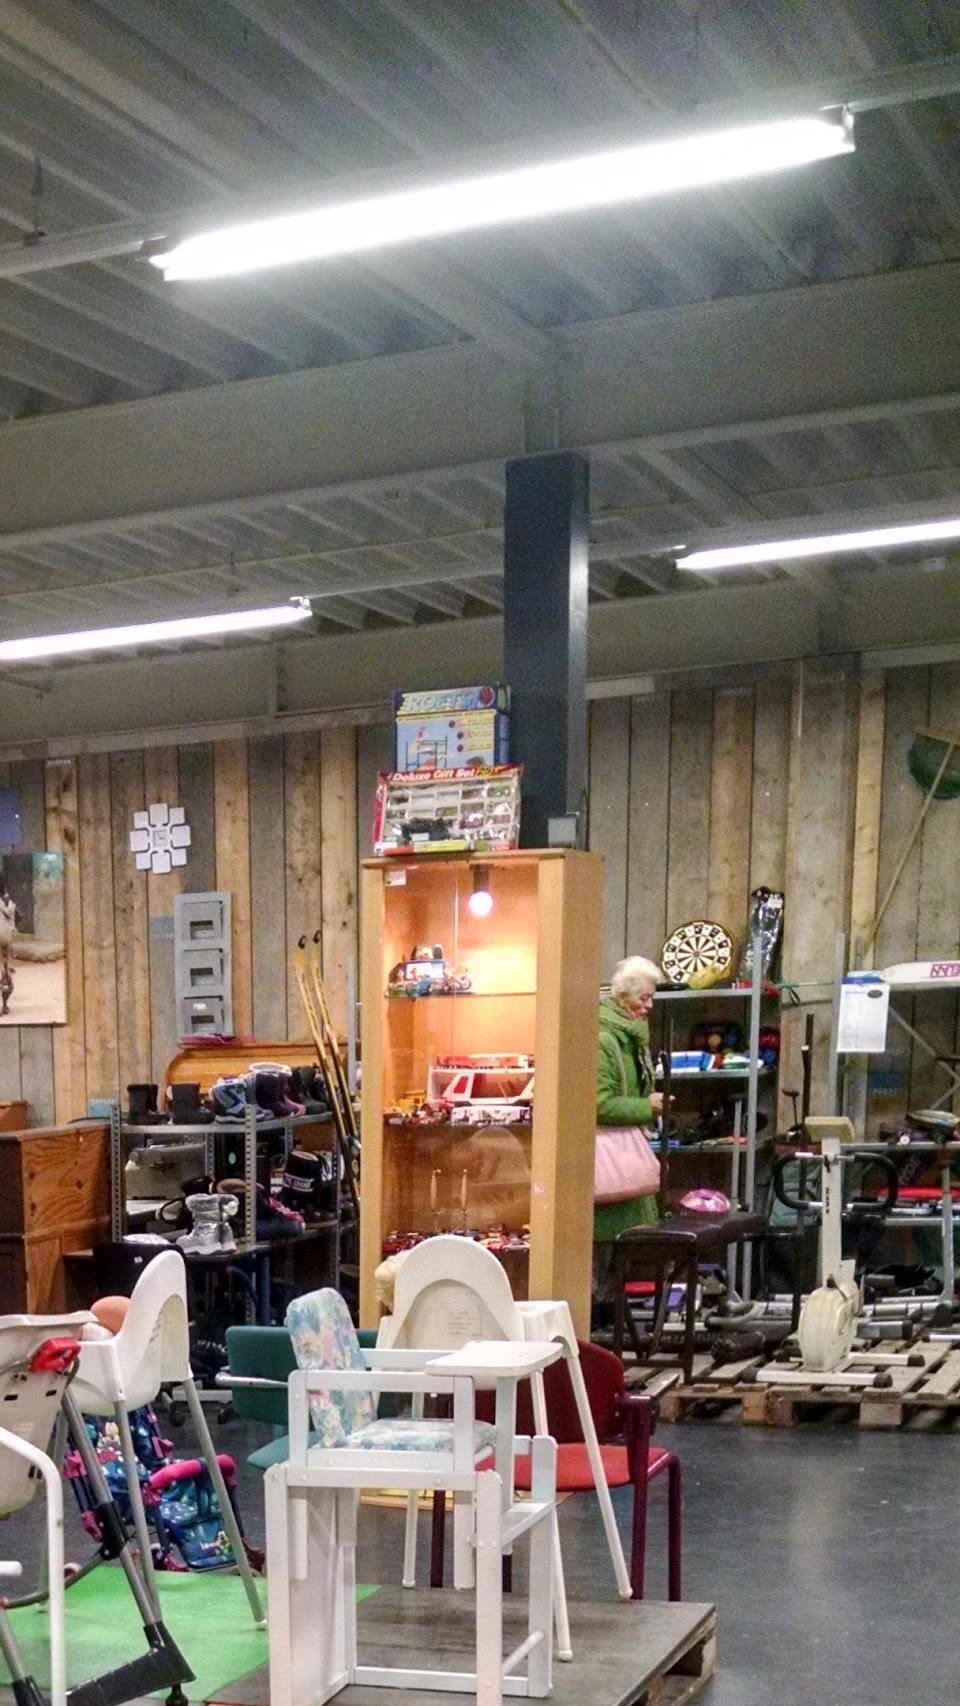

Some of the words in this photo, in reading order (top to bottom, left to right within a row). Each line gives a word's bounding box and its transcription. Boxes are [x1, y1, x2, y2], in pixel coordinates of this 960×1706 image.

[392, 771, 431, 781] Deluxe
[433, 768, 454, 779] Gift
[455, 767, 476, 778] Set
